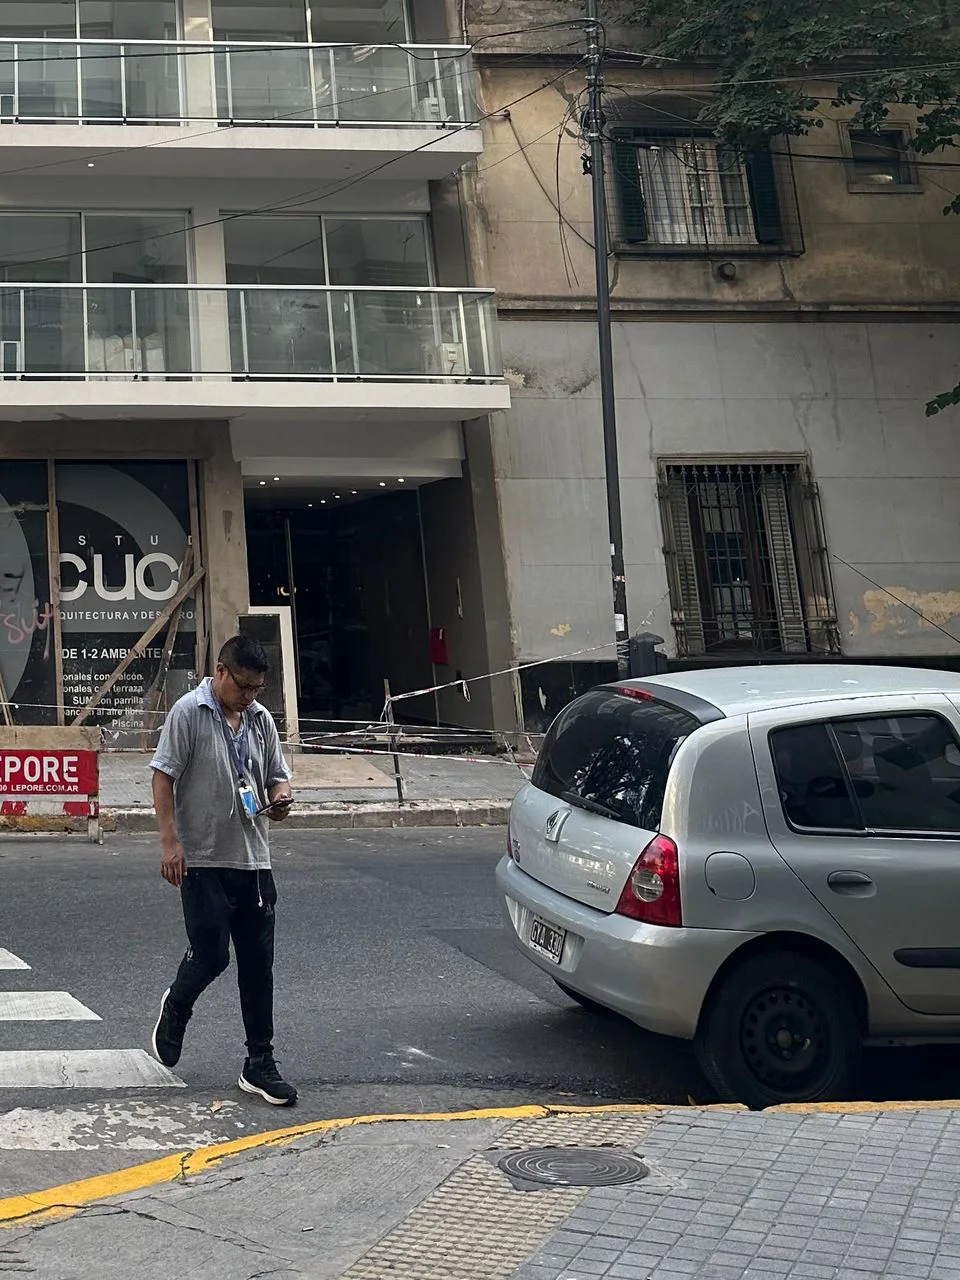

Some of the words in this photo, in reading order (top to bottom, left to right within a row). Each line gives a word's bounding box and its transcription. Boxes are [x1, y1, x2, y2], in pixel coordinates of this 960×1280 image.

[59, 552, 184, 601] cuc
[81, 648, 98, 659] 1-2
[112, 719, 144, 728] Piscina
[11, 784, 79, 792] LEPORE.COM.AR
